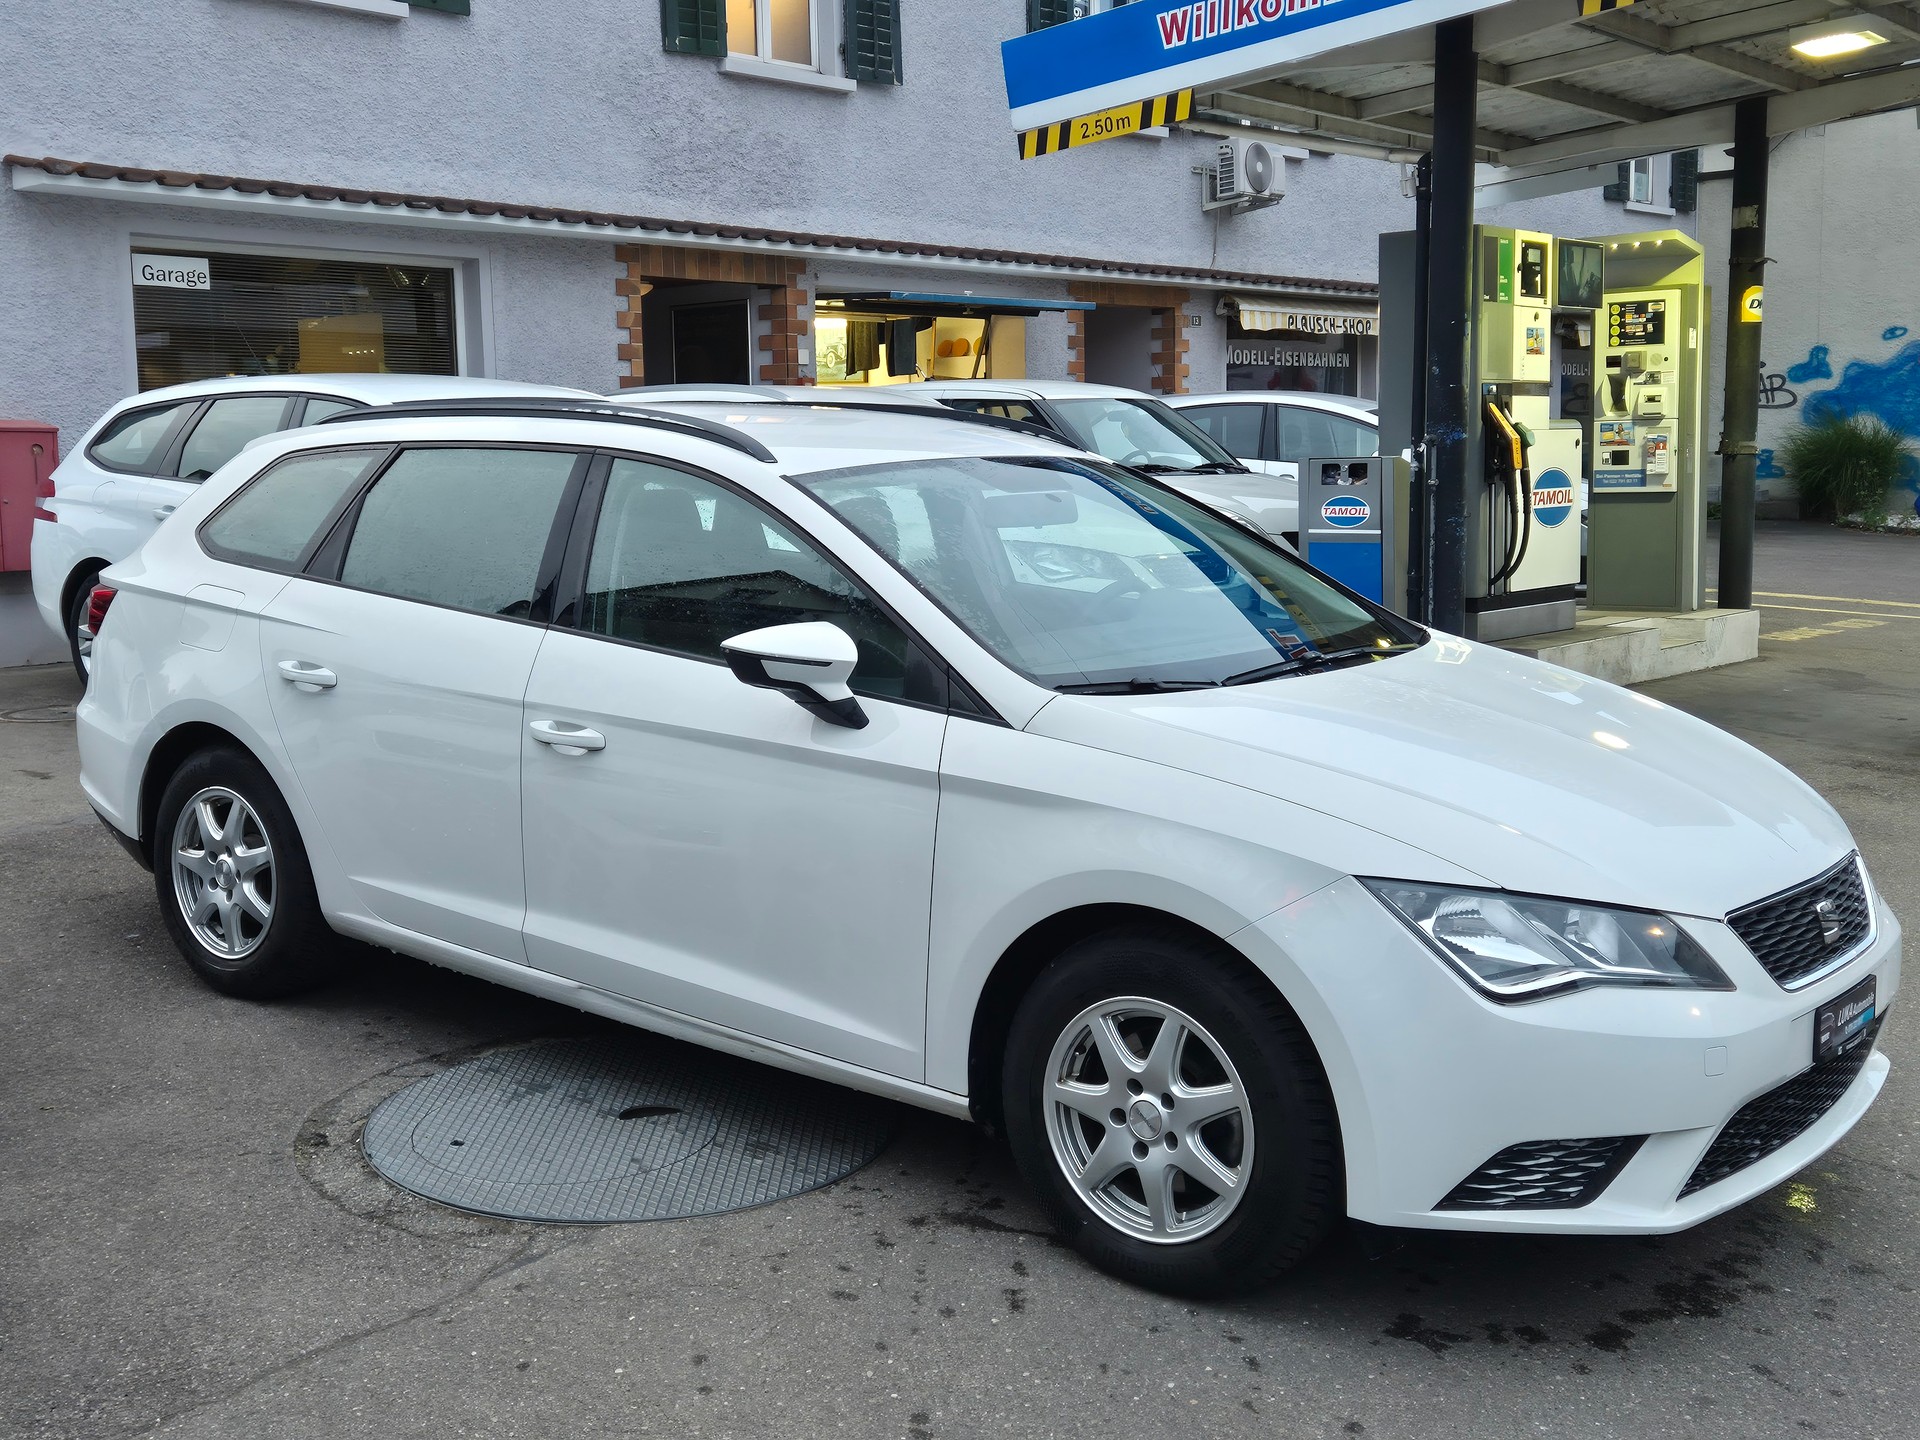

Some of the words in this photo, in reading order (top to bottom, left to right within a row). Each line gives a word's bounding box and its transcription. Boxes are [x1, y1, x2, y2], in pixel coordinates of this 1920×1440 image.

[1157, 0, 1343, 49] Willko
[142, 264, 207, 288] Garage
[1288, 314, 1372, 336] PLAUSCH-SHOP
[1561, 361, 1591, 377] ODELL-
[1532, 489, 1573, 506] TAMOIL
[1323, 507, 1369, 516] TAMOIL
